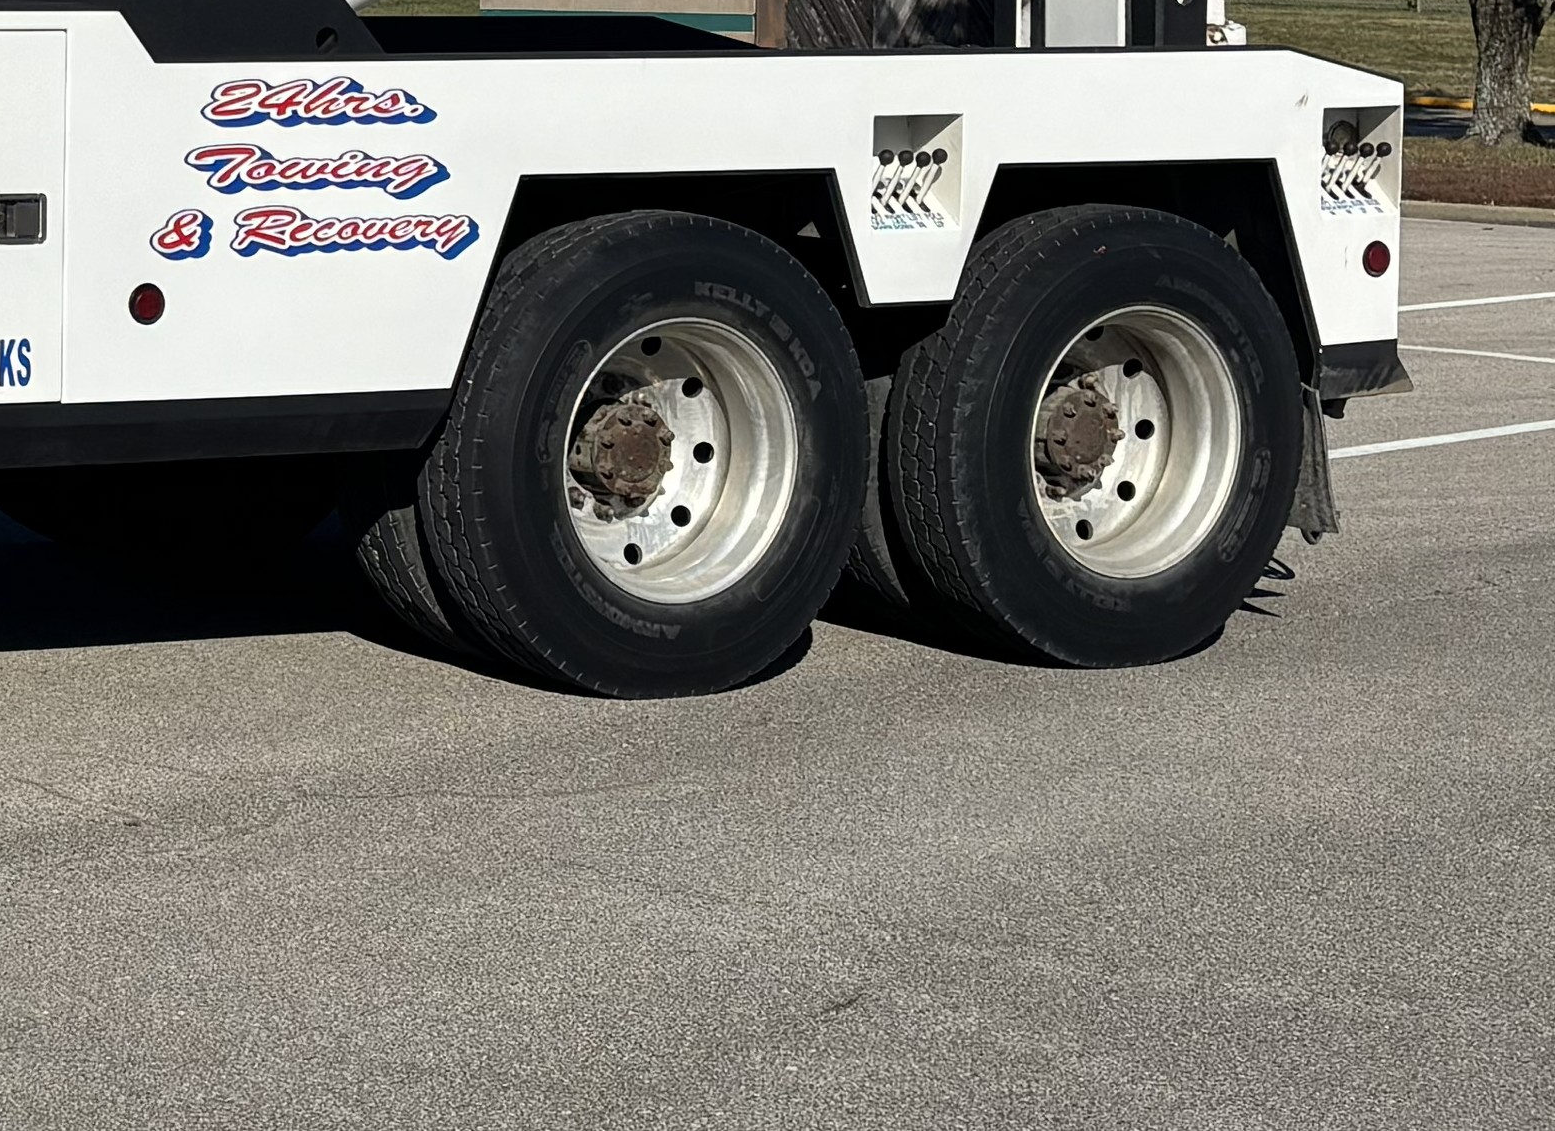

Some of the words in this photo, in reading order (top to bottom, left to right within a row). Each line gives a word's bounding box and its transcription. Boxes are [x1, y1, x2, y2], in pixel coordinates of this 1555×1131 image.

[201, 76, 437, 128] 24hrs.
[183, 143, 452, 200] Towing
[149, 208, 213, 261] &
[229, 204, 481, 261] Recovery
